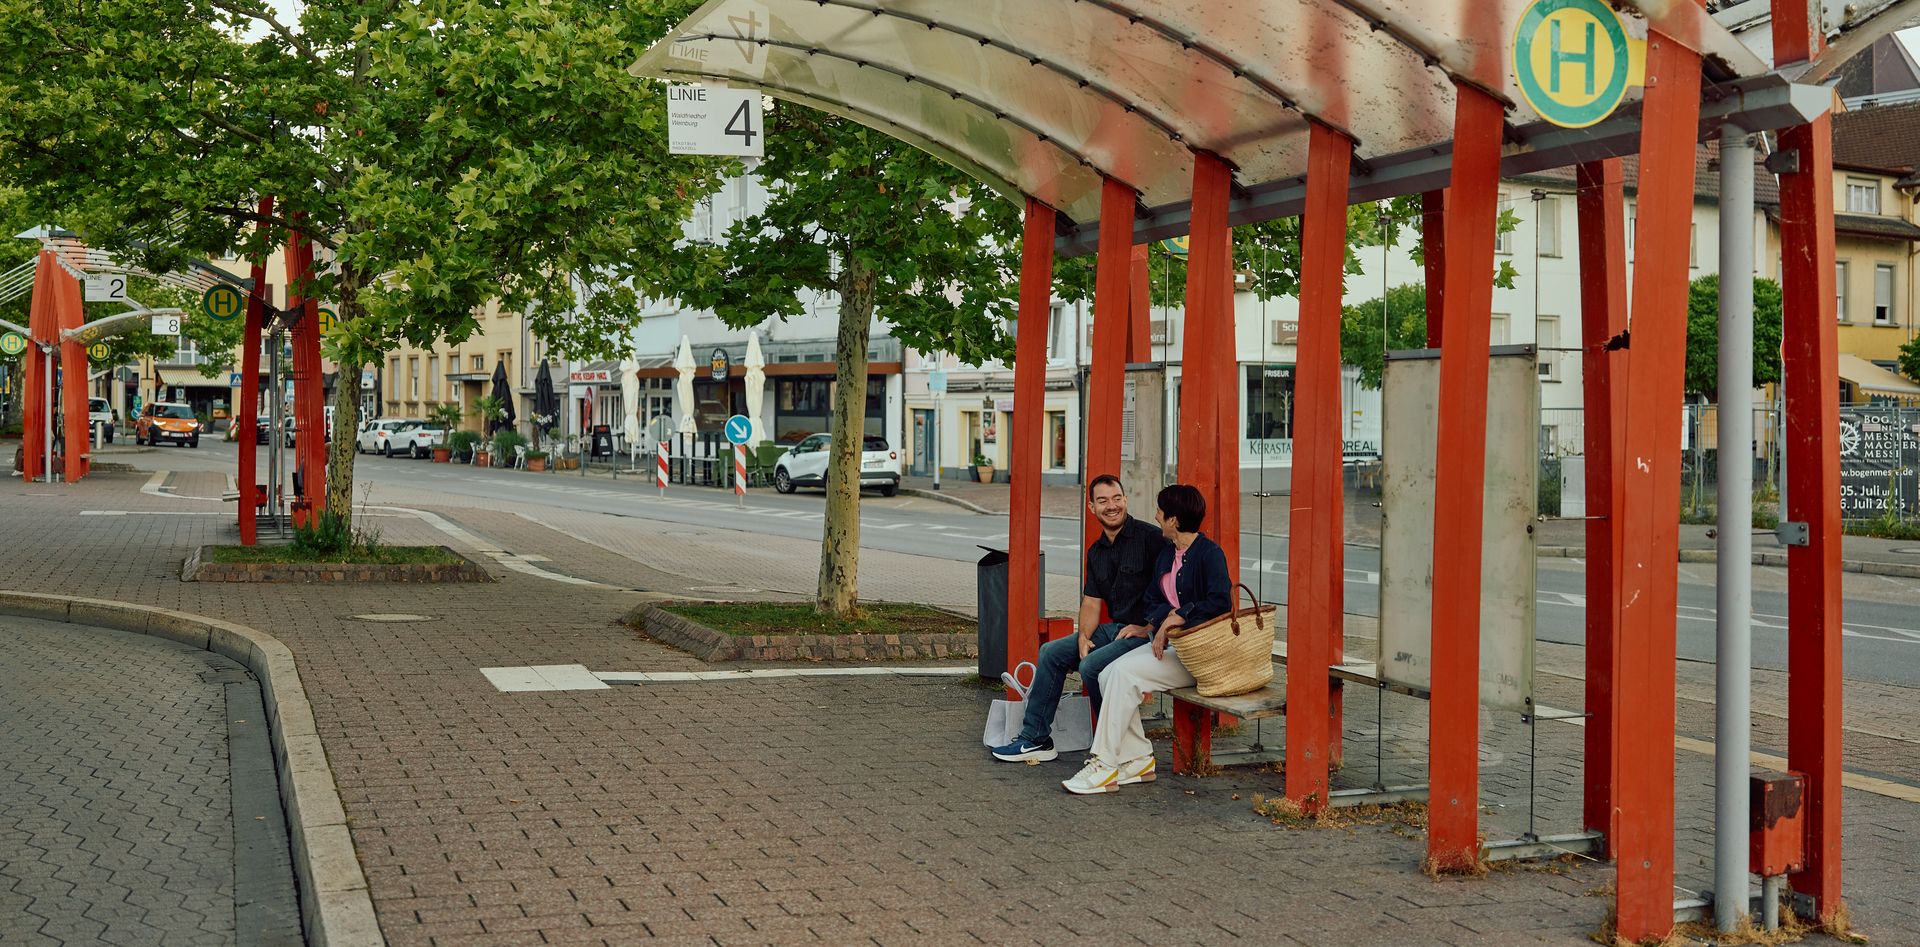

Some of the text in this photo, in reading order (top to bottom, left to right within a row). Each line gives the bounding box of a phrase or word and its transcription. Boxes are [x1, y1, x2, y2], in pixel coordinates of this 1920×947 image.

[1550, 19, 1595, 95] H
[670, 88, 707, 101] LINIE
[724, 99, 757, 147] 4
[110, 279, 124, 298] 2
[215, 292, 232, 313] H
[168, 319, 179, 333] 8
[1282, 323, 1298, 332] Sch
[7, 336, 18, 349] H
[95, 345, 104, 356] H
[1264, 369, 1289, 378] FRISEUR
[1249, 440, 1292, 455] KÉRASTA
[1840, 485, 1857, 496] 05.
[1860, 485, 1880, 496] Juli
[1840, 498, 1850, 509] 6.
[1853, 498, 1872, 509] Juli
